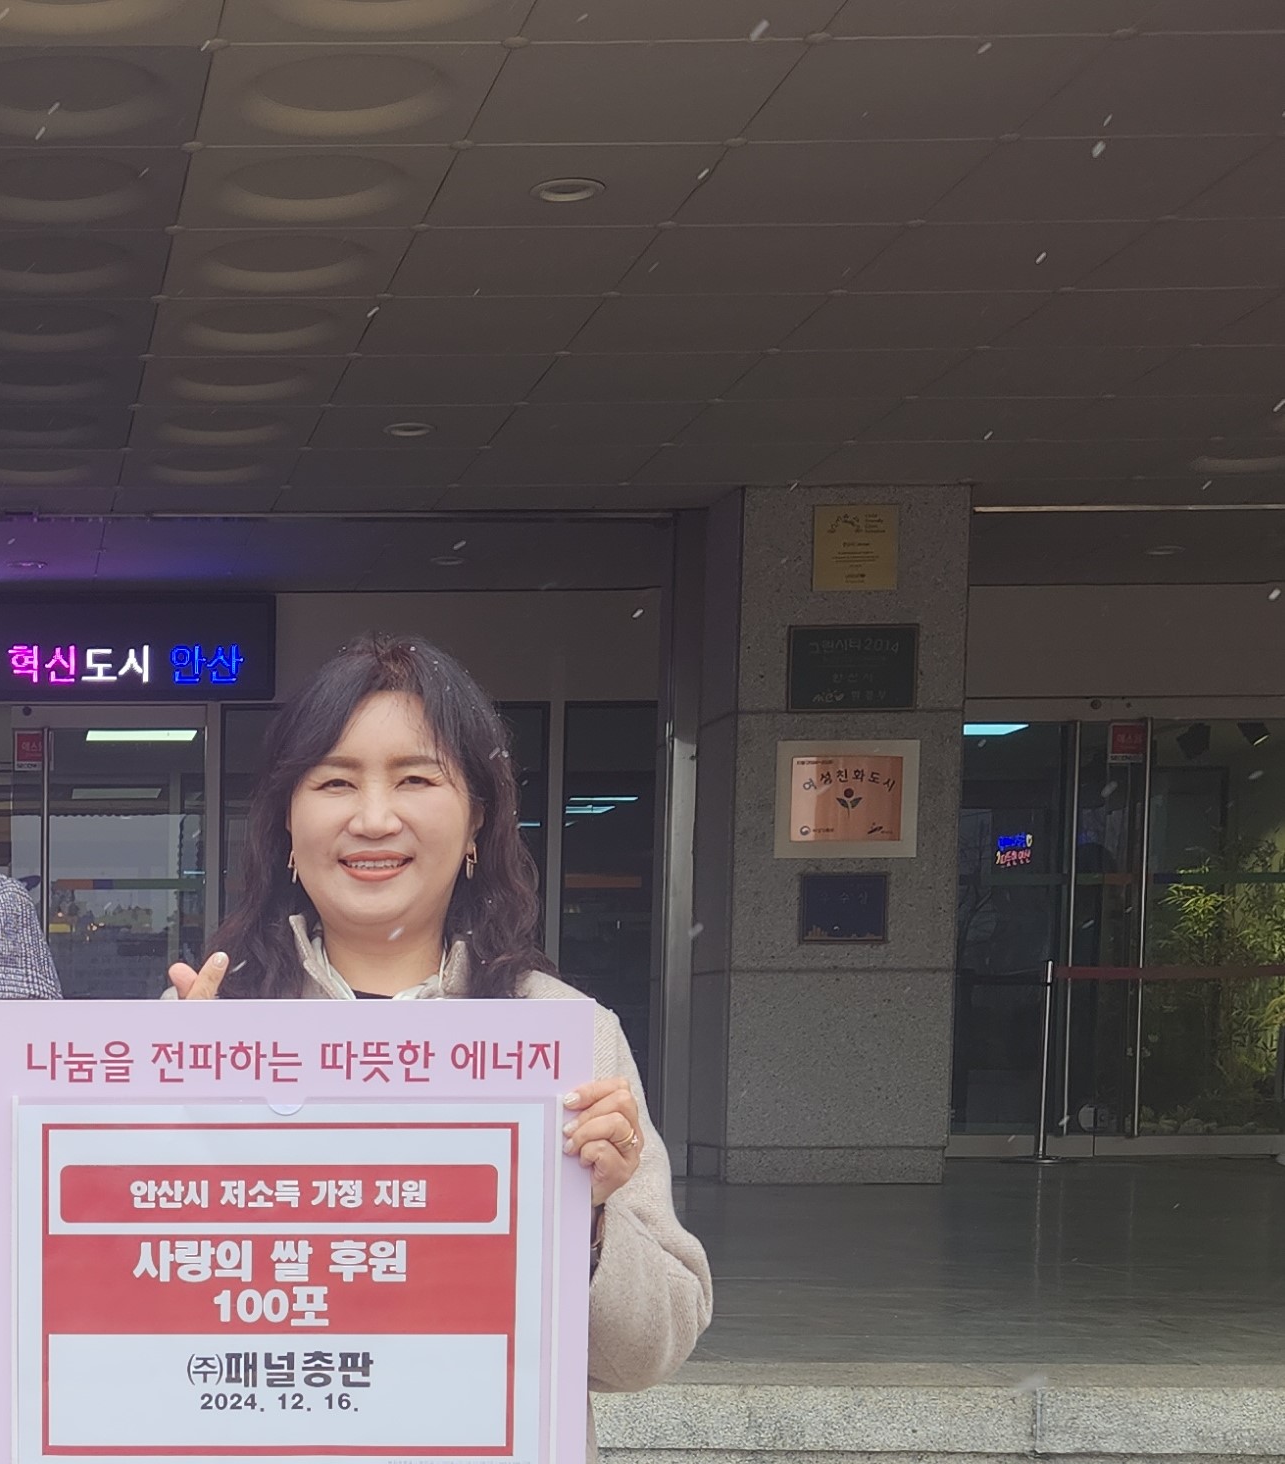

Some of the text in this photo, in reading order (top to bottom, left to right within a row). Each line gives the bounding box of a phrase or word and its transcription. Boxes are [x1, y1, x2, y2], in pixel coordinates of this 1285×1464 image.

[7, 644, 151, 684] 혁신도시
[169, 643, 245, 685] 안산
[802, 768, 896, 792] 여성친화도시
[26, 1040, 561, 1083] 나눔을 전파하는 따뜻한 에너지
[129, 1179, 427, 1209] 안산시 저소득 가정 지원
[132, 1239, 407, 1283] 사랑의 쌀 후원
[213, 1285, 330, 1327] 100포
[200, 1392, 359, 1413] 2024. 12. 16.
